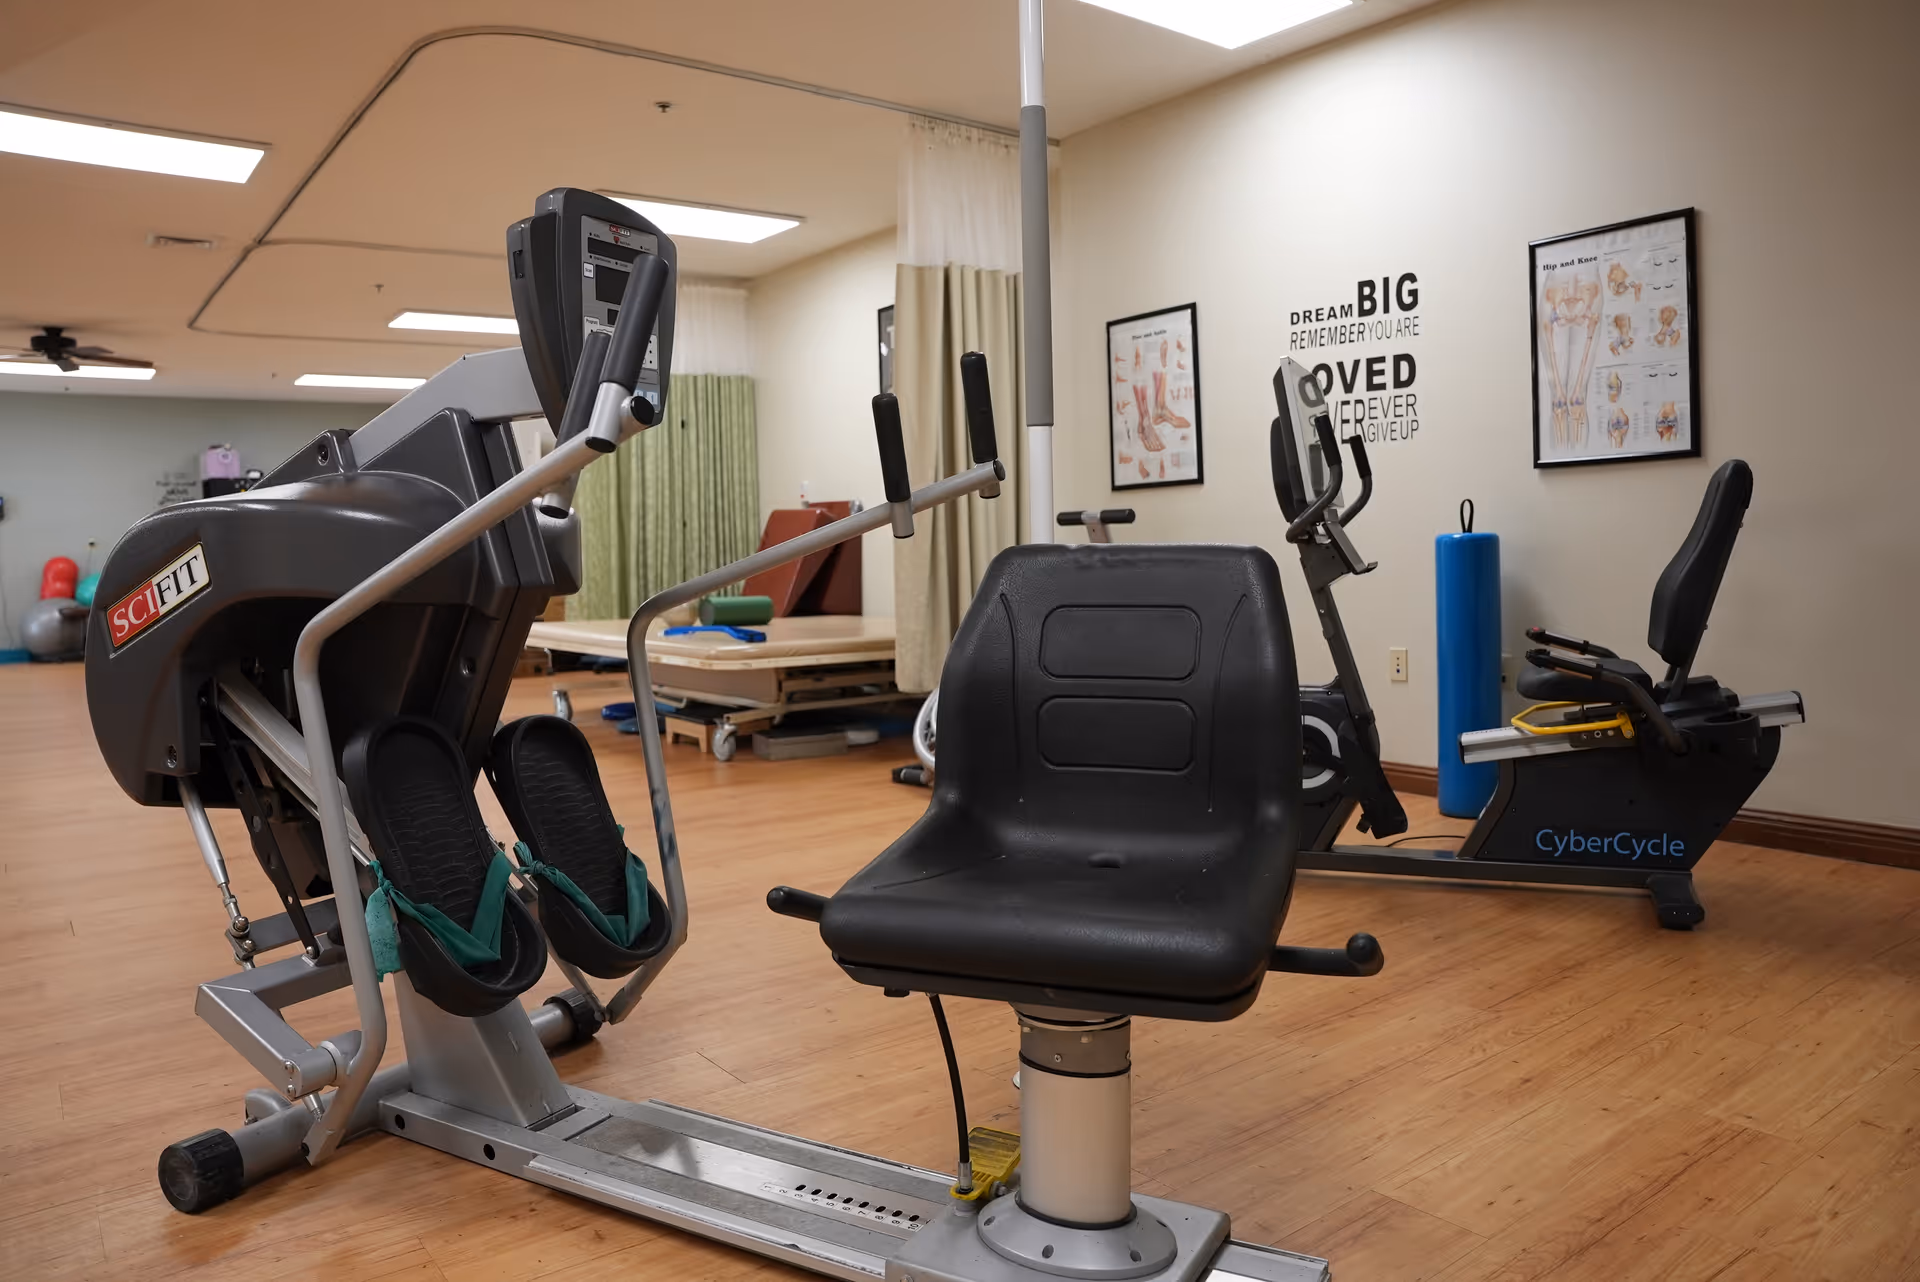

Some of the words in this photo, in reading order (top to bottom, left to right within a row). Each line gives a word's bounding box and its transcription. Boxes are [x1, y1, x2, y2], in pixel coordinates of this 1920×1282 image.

[1560, 259, 1575, 267] and
[1577, 256, 1598, 264] Knee
[1290, 304, 1353, 325] DREAM
[1357, 272, 1418, 318] BIG
[1290, 322, 1365, 351] REMEMBER
[1366, 320, 1393, 342] YOU
[1395, 316, 1419, 338] ARE
[1312, 353, 1417, 396] OVED
[1326, 399, 1367, 444] VER
[1368, 394, 1418, 419] EVER
[1367, 422, 1397, 442] GIVE
[1400, 420, 1419, 440] UP
[113, 555, 198, 638] SCIFIT
[1535, 829, 1685, 860] CyberCycle
